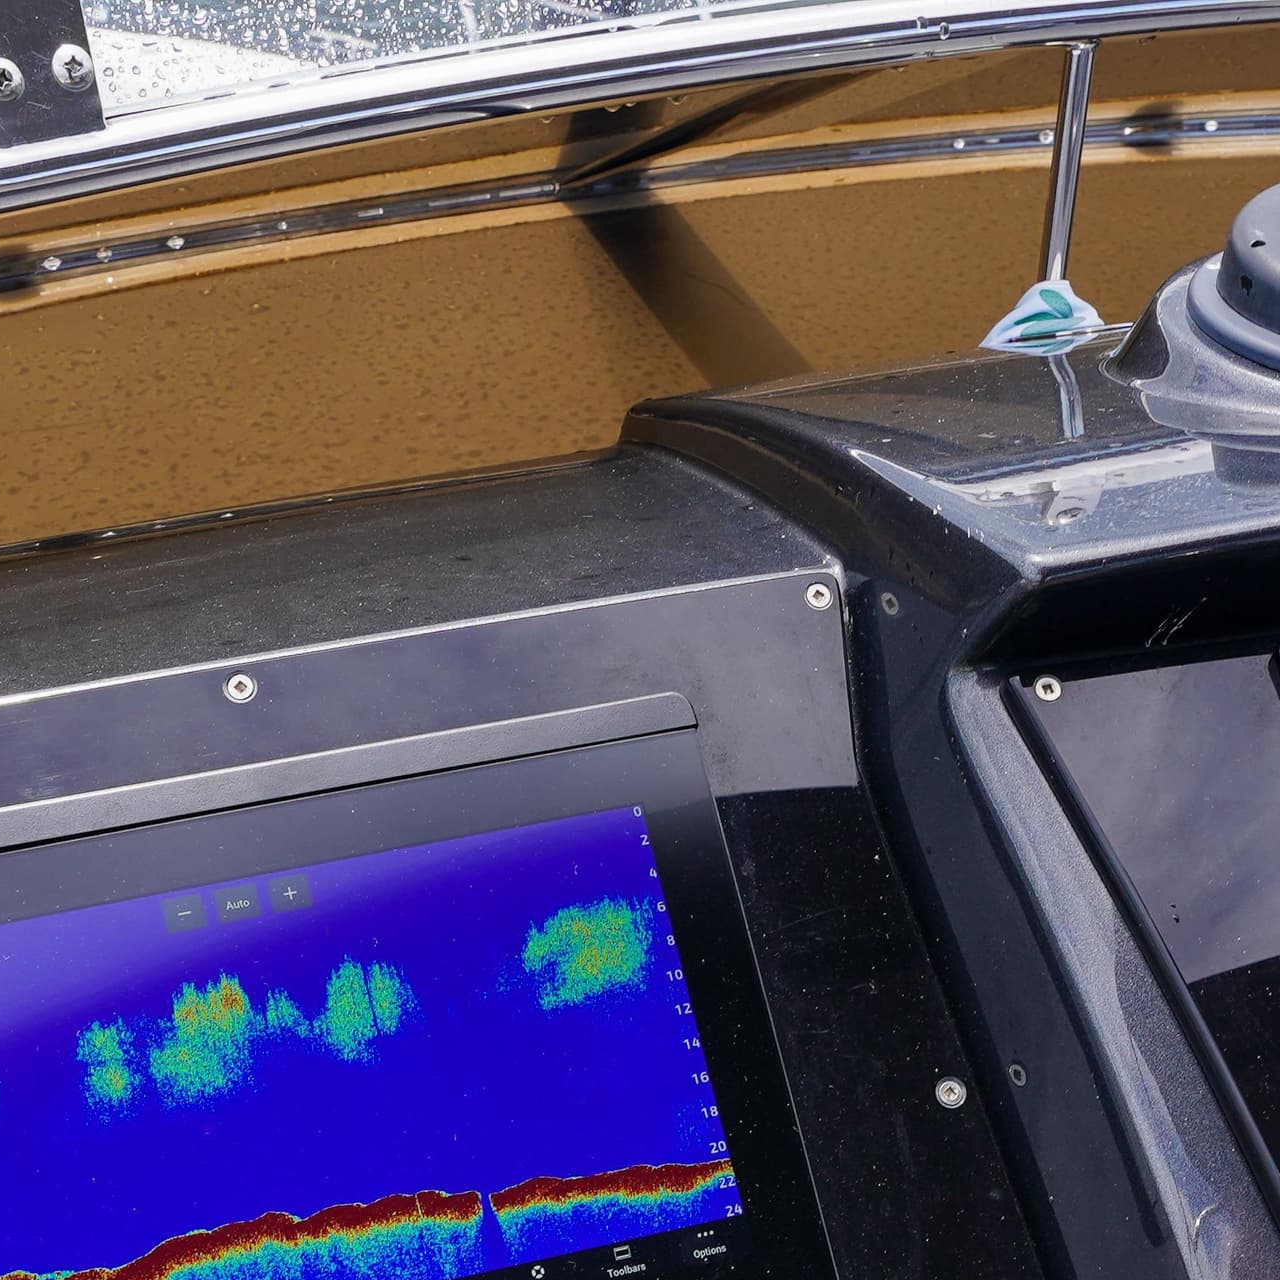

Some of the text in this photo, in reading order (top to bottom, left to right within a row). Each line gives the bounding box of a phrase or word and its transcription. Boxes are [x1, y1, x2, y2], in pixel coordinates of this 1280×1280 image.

[633, 806, 642, 817] 0
[640, 835, 650, 846] 2
[649, 868, 658, 878] 4
[226, 898, 250, 911] Auto
[657, 901, 666, 912] 6
[666, 935, 676, 946] 8
[666, 968, 684, 982] 10
[674, 1002, 693, 1016] 12
[683, 1036, 701, 1050] 14
[691, 1071, 710, 1084] 16
[701, 1105, 719, 1119] 18
[709, 1140, 727, 1154] 20
[719, 1175, 736, 1189] 22
[725, 1203, 743, 1217] 24
[693, 1243, 727, 1260] Options
[607, 1262, 647, 1278] Toolbars
